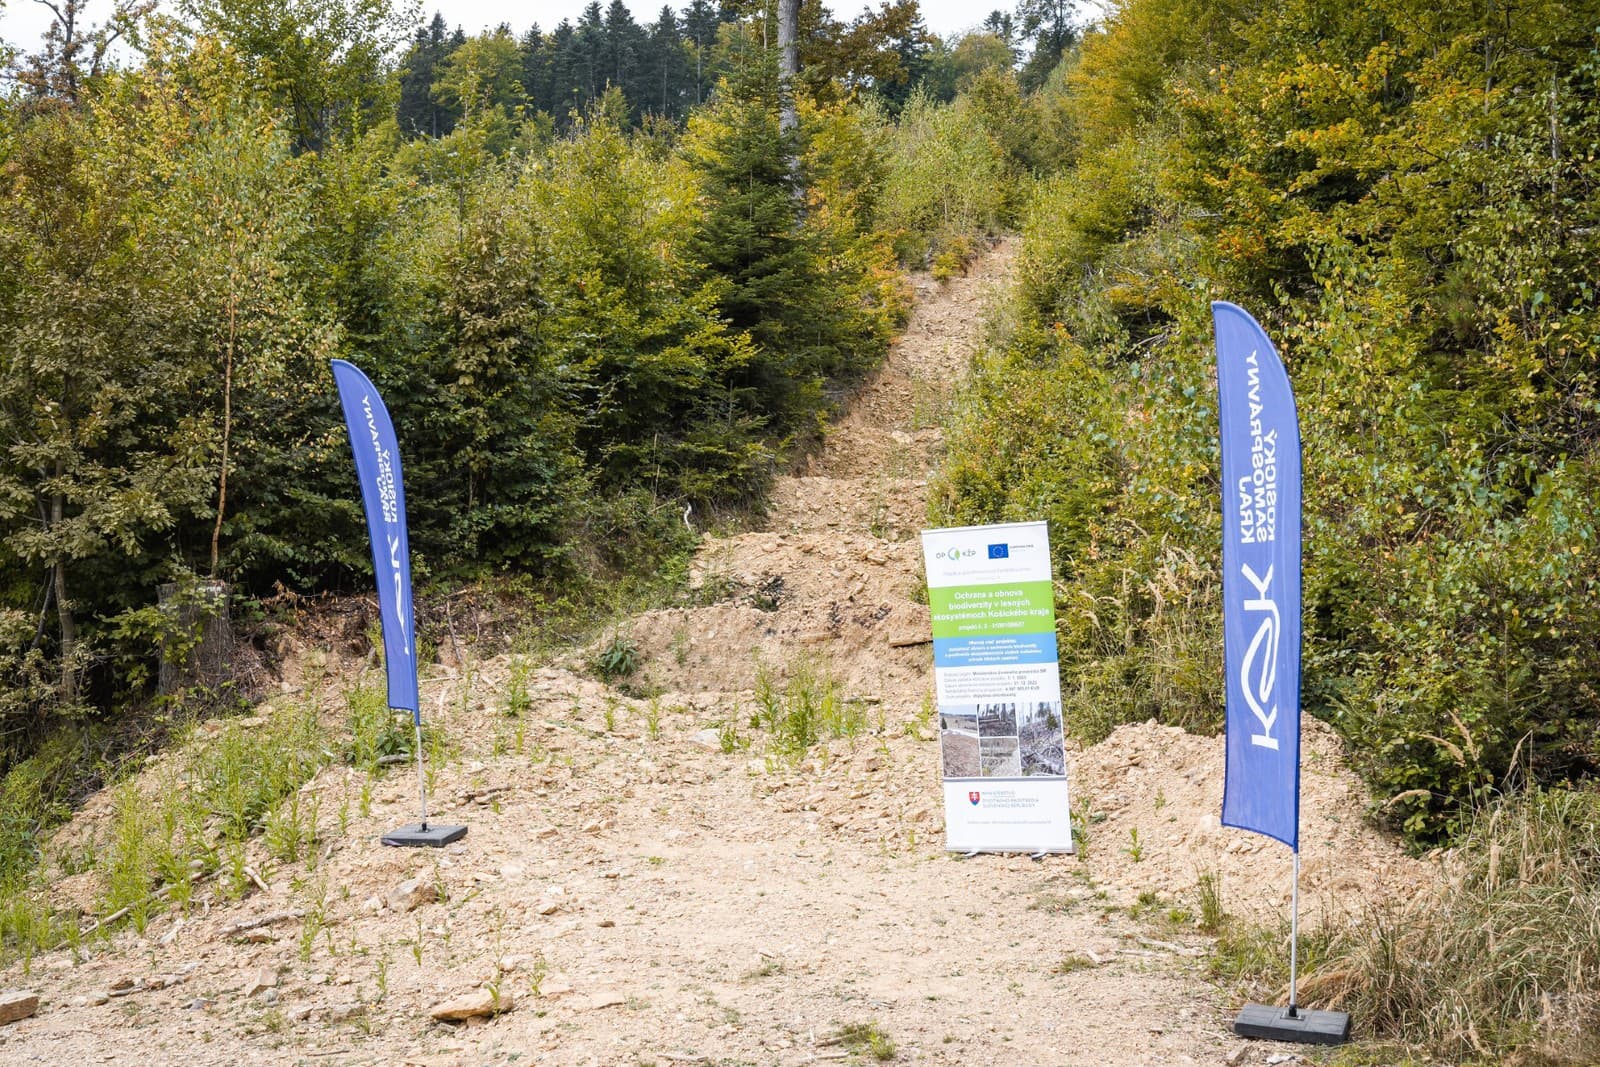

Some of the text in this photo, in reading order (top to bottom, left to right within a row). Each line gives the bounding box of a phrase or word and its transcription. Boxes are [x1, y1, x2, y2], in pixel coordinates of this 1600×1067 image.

[954, 591, 987, 600] Ochrana
[994, 590, 1023, 598] obnova
[948, 601, 993, 612] biodiverzity
[1000, 598, 1031, 608] lesných
[988, 609, 1029, 618] Košického
[1029, 608, 1050, 616] kraja
